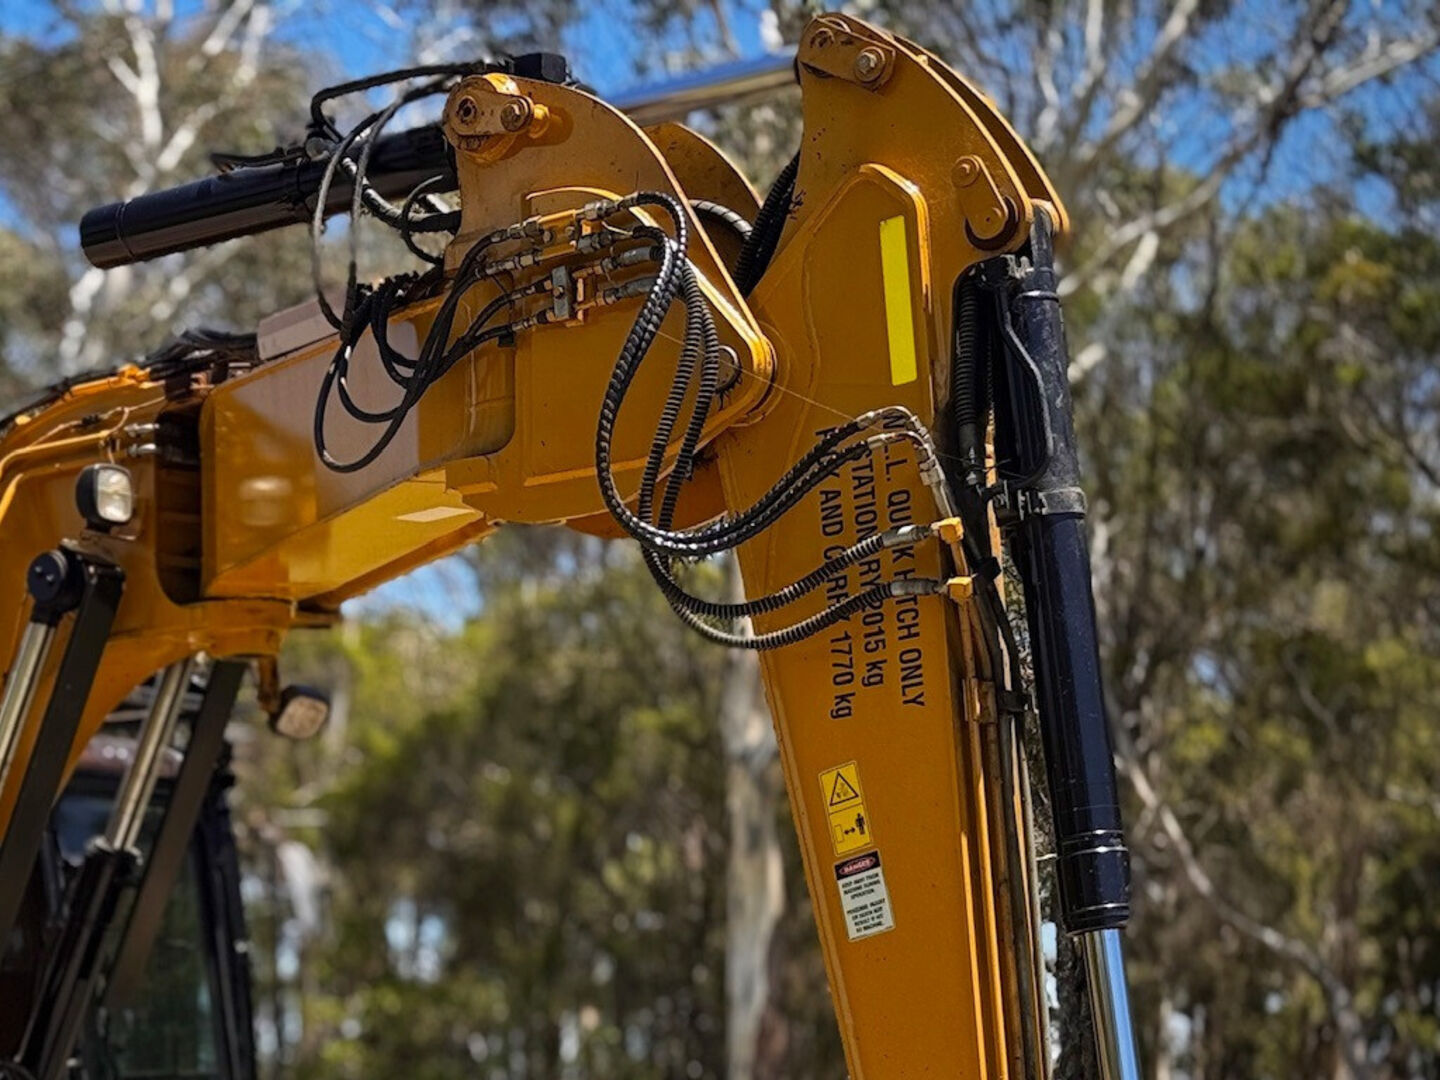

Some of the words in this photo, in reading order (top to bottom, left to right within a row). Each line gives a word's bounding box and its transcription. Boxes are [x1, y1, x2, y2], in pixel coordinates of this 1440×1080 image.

[820, 490, 844, 536] AND
[893, 568, 920, 641] HTCH
[830, 630, 855, 686] 1770
[862, 659, 888, 687] kg
[899, 648, 926, 707] ONLY
[830, 692, 856, 719] kg
